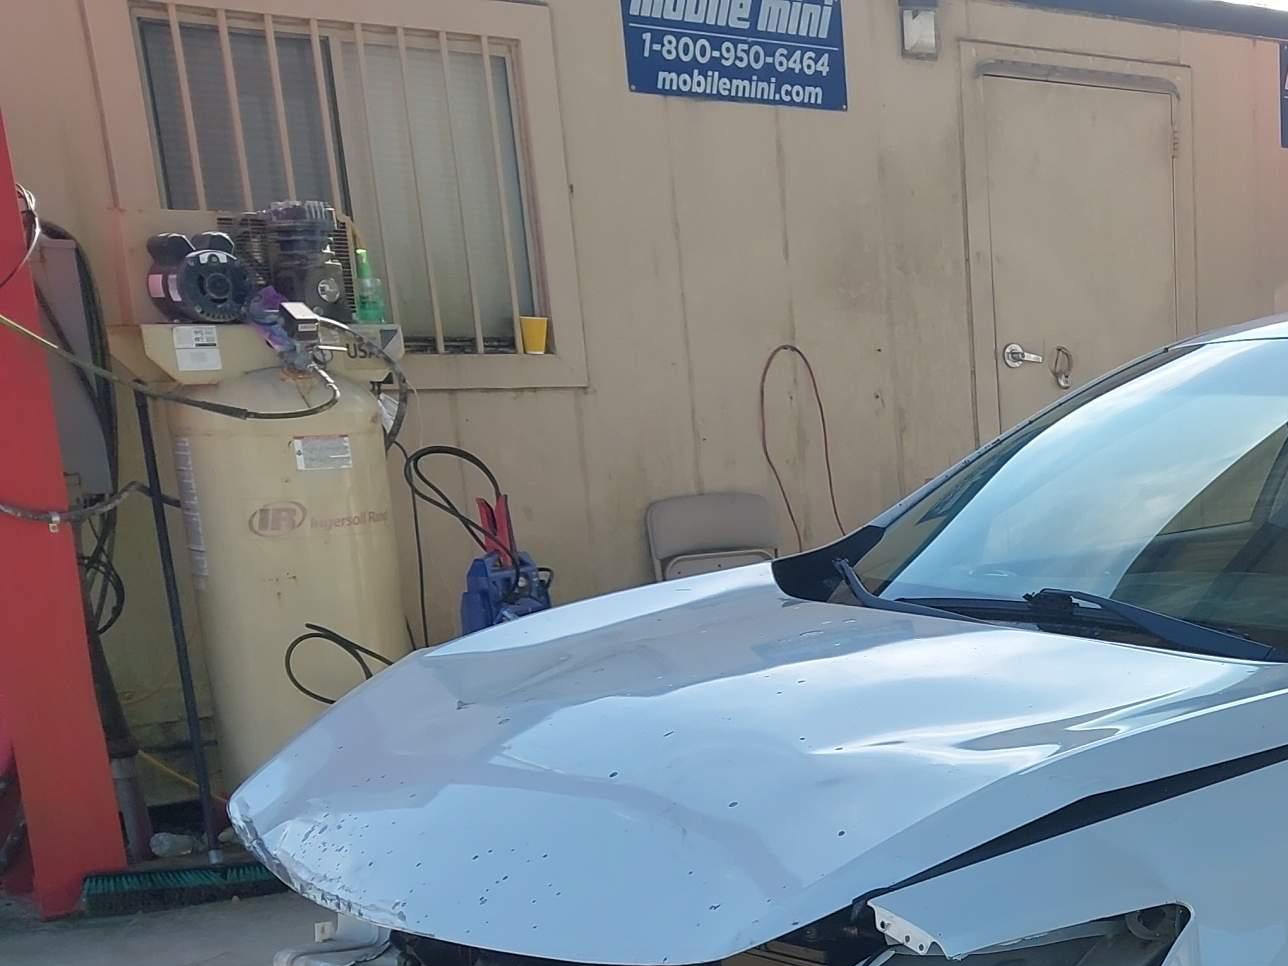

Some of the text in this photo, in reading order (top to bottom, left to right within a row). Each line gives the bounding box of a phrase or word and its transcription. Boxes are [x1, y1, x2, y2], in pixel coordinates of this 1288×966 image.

[757, 0, 833, 39] mini
[641, 32, 830, 77] 1-800-950-6464
[656, 69, 823, 105] mobilemini.com
